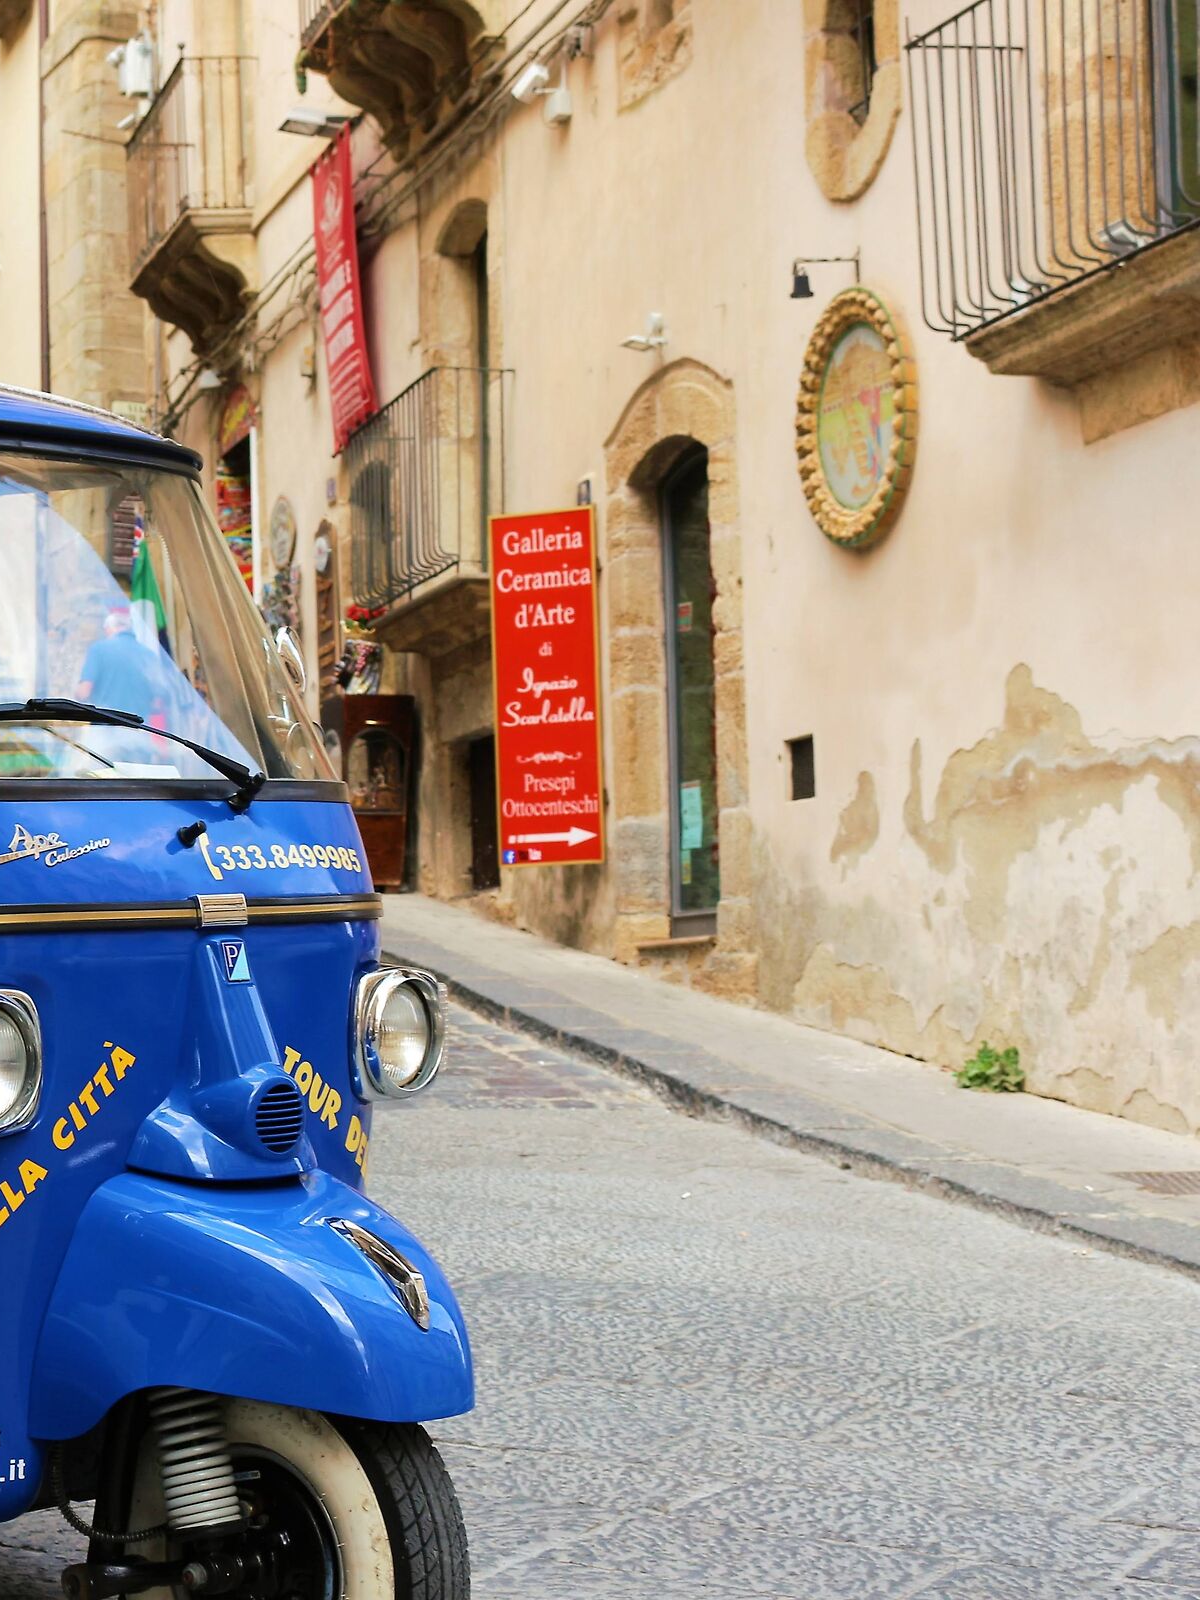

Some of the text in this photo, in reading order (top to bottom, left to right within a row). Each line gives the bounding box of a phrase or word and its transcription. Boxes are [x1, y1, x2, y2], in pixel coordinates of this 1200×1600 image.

[502, 526, 583, 556] Galleria
[496, 563, 592, 593] Ceramica
[514, 602, 576, 629] d'Arte
[538, 641, 553, 657] di
[516, 666, 578, 699] Ignazio
[524, 770, 576, 796] Presepi
[502, 793, 599, 818] Ottocenteschi
[7, 823, 69, 860] Ape
[45, 837, 111, 867] Calessino
[216, 844, 362, 873] 333.8499985
[52, 1041, 136, 1150] CITTÀ
[283, 1045, 342, 1131] TOUR
